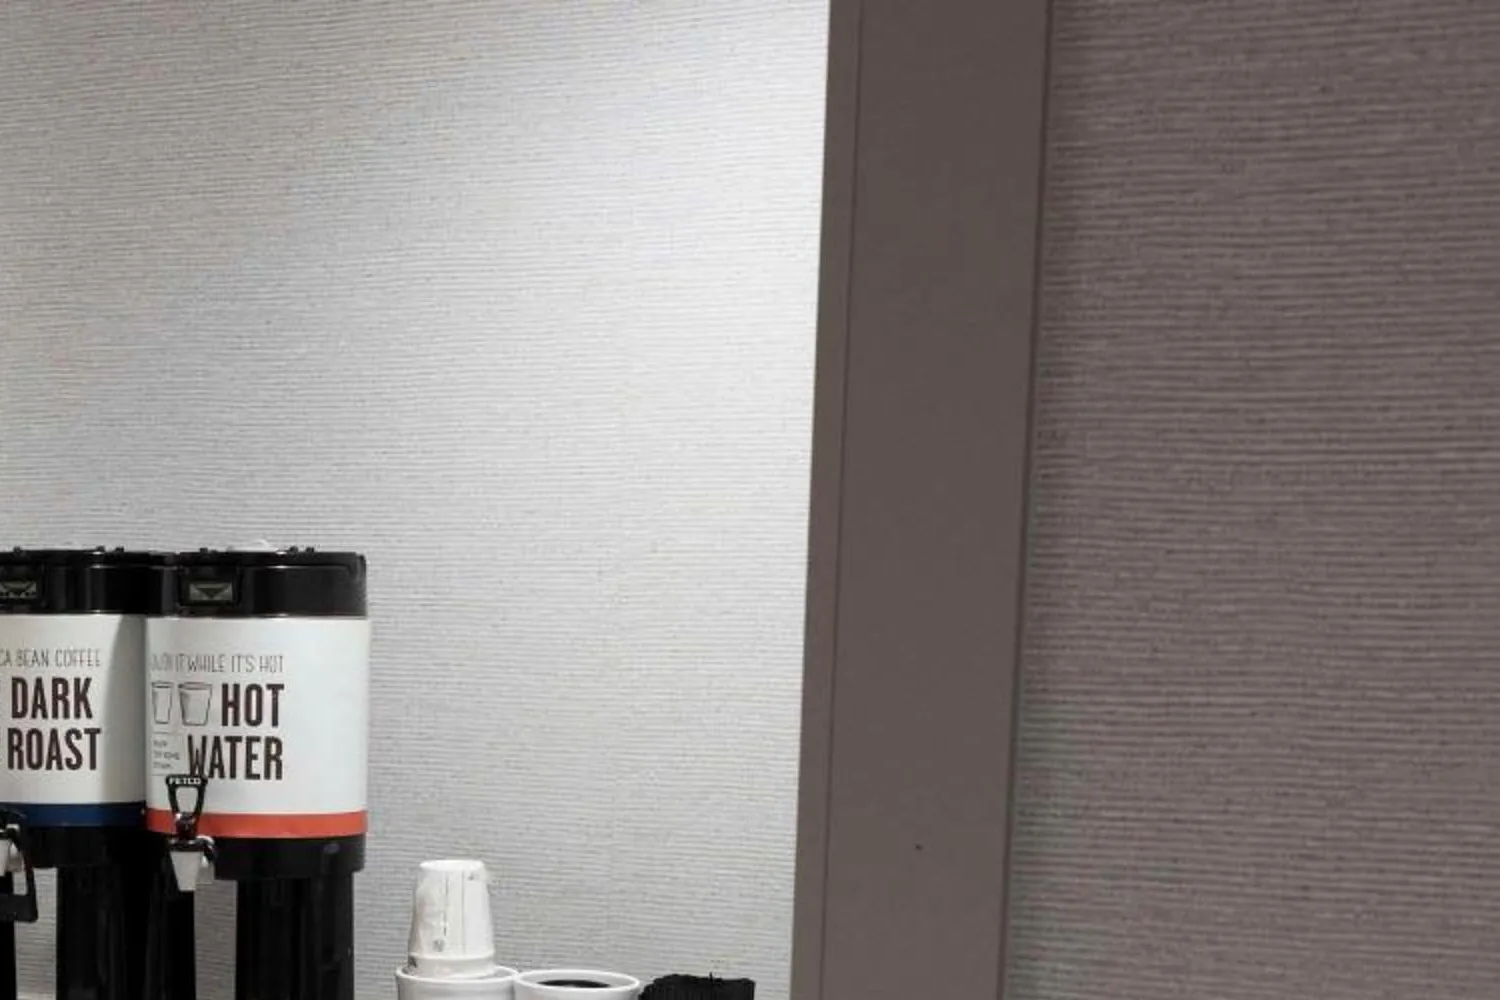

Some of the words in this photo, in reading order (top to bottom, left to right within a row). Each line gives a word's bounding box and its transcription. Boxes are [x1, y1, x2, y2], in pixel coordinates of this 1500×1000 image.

[17, 648, 49, 667] BEAN
[55, 648, 101, 667] COFFEE
[187, 654, 226, 673] WHILE
[230, 654, 256, 673] IT'S
[259, 654, 284, 673] HOT
[11, 676, 93, 719] DARK
[221, 683, 285, 727] HOT
[7, 727, 102, 771] ROAST
[187, 734, 283, 780] WATER
